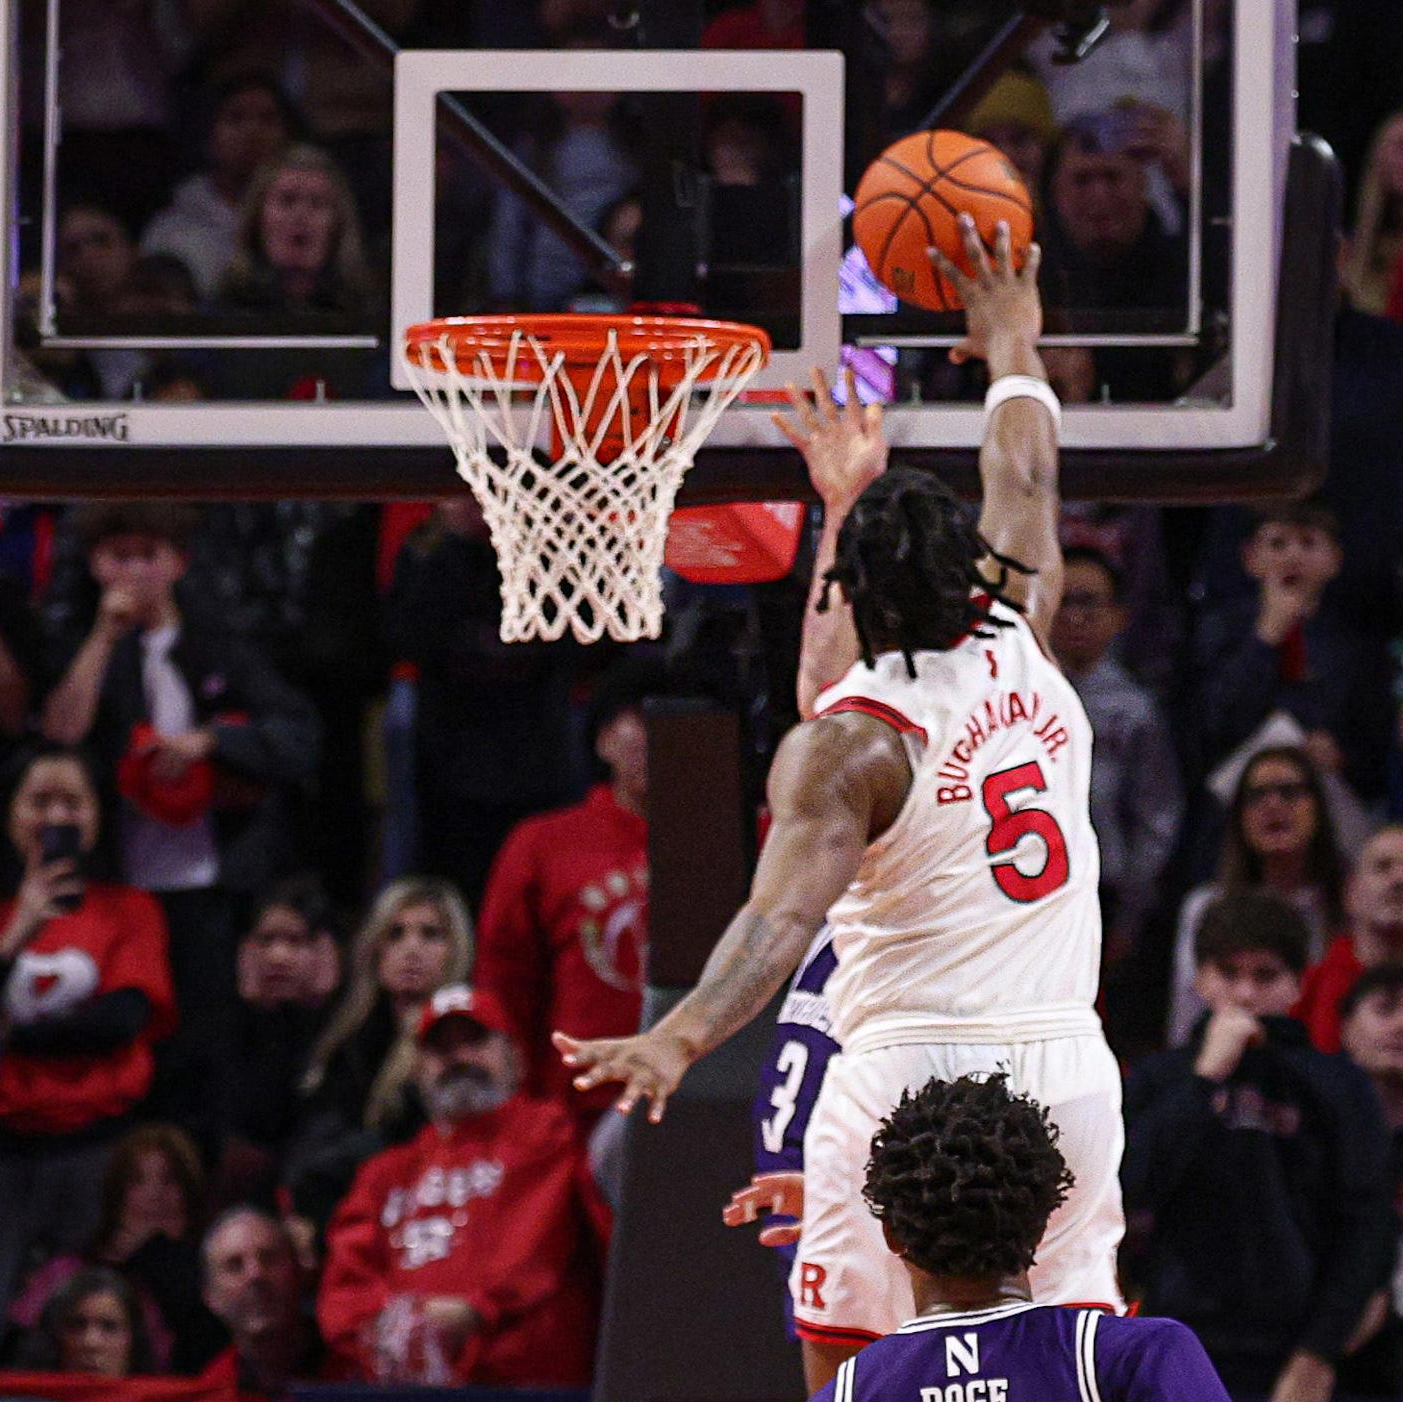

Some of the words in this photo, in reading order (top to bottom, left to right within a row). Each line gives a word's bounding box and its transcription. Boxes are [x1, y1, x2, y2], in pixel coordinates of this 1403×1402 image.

[3, 414, 128, 441] SPALDING
[981, 760, 1071, 903] 5
[761, 1040, 809, 1153] 3
[800, 1262, 827, 1310] R
[945, 1333, 980, 1377] N
